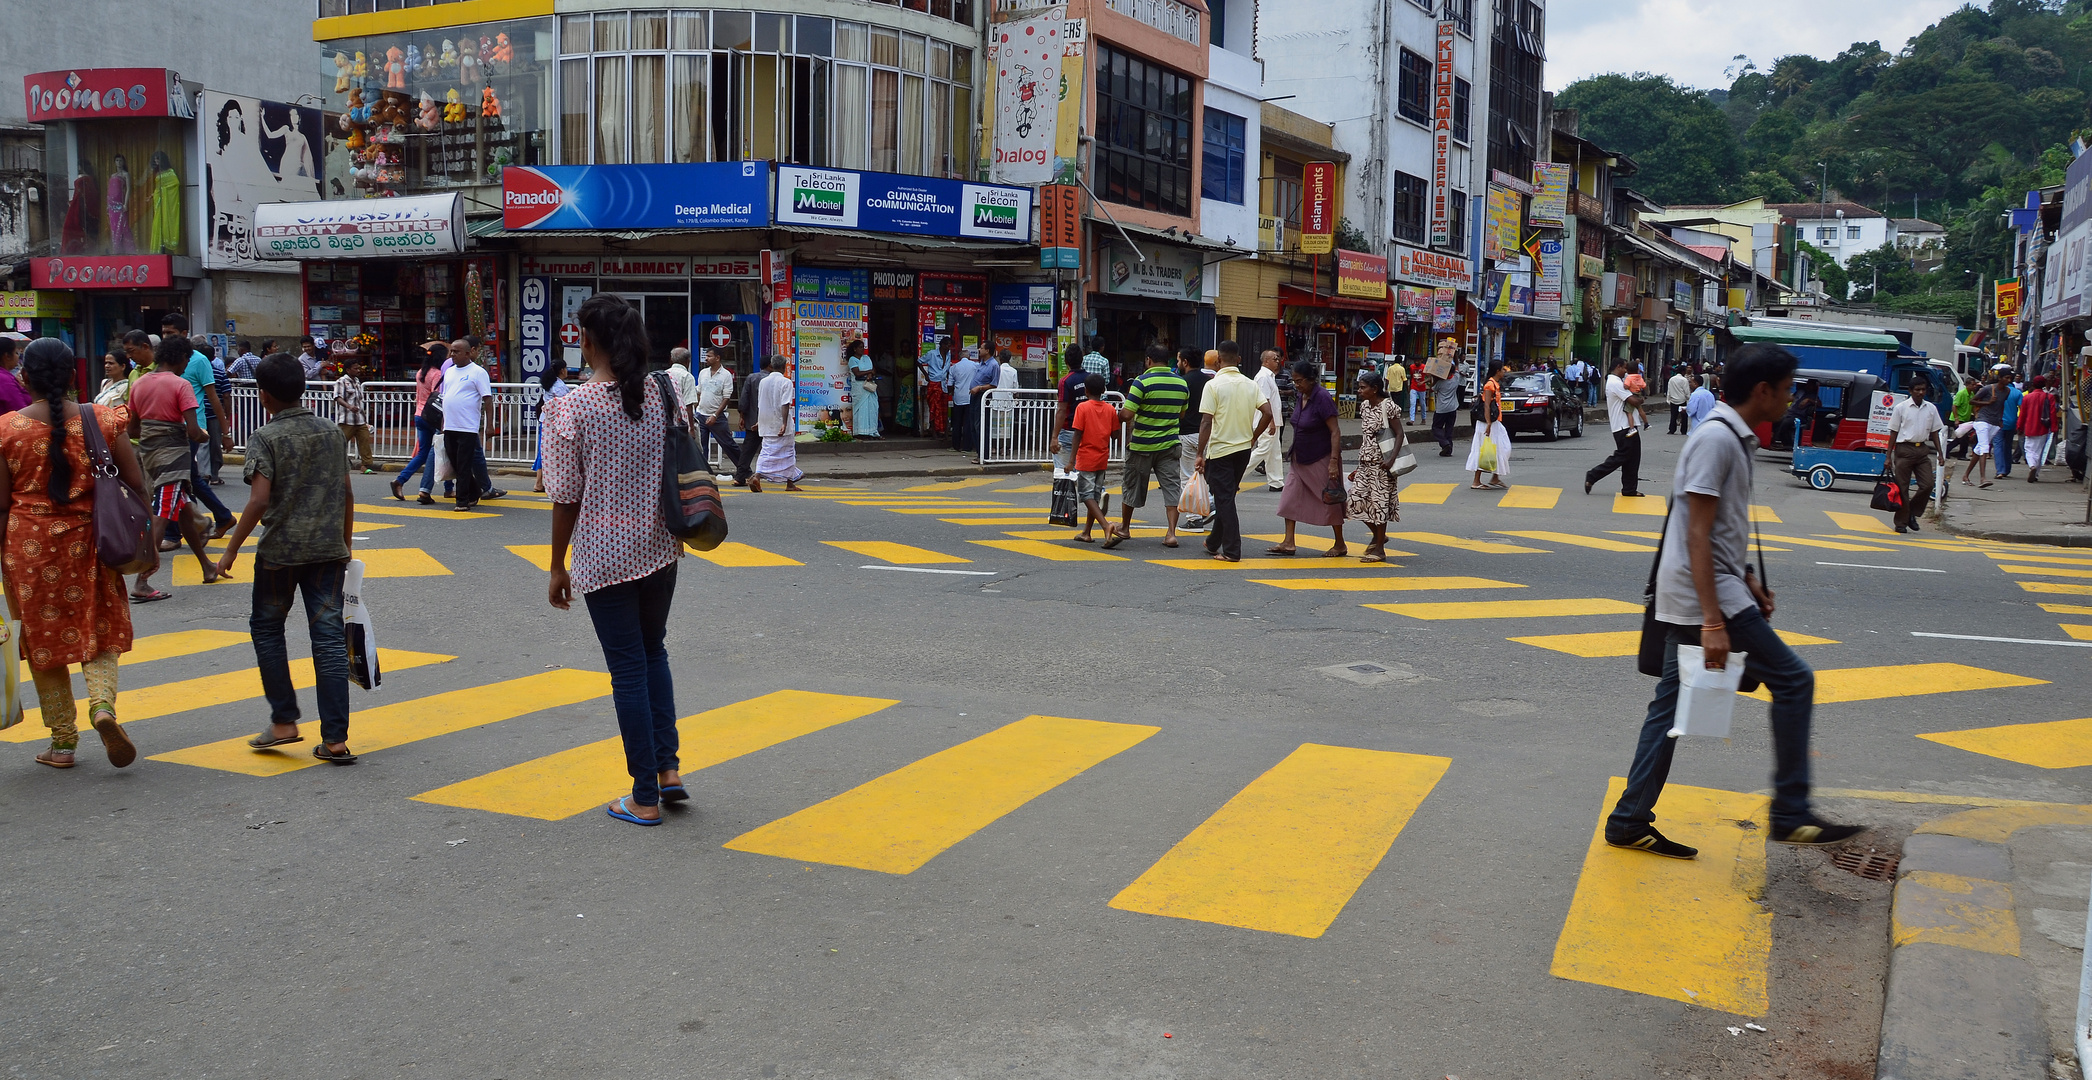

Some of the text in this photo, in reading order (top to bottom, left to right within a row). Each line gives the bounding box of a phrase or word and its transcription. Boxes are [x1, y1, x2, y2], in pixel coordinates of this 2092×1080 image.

[1436, 40, 1452, 131] KURUGAMA
[30, 84, 147, 116] Poomas
[794, 174, 846, 191] Telecom
[812, 172, 846, 182] Sri Lanka
[1435, 135, 1447, 218] ENTERPRISES
[506, 189, 559, 205] Panadol
[797, 192, 841, 210] Mobitel
[887, 191, 937, 203] GUNASIRI
[975, 192, 1018, 207] Telecom
[1310, 167, 1328, 230] asianpaints
[675, 203, 752, 217] Deepa Medical
[866, 198, 954, 214] COMMUNICATION
[976, 208, 1014, 224] Mobitel
[261, 219, 443, 236] BEAUTY CENTRE
[270, 232, 437, 252] ගුණසිරි බියුටි සෙන්ටර්
[603, 262, 686, 274] PHARMACY
[1340, 257, 1363, 273] asianpaints
[1412, 250, 1465, 273] KURUGAMA
[47, 258, 150, 285] Poomas
[794, 275, 819, 283] Telecom
[873, 271, 896, 286] PHOTO
[896, 273, 914, 287] COPY
[1133, 263, 1182, 280] M. B. S. TRADERS
[795, 285, 818, 294] Mobitel
[825, 277, 850, 286] Telecom
[827, 287, 848, 296] Mobitel
[1436, 288, 1453, 296] VENU
[798, 303, 860, 319] GUNASIRI
[801, 319, 858, 328] COMMUNICATION
[996, 337, 1012, 347] 3G
